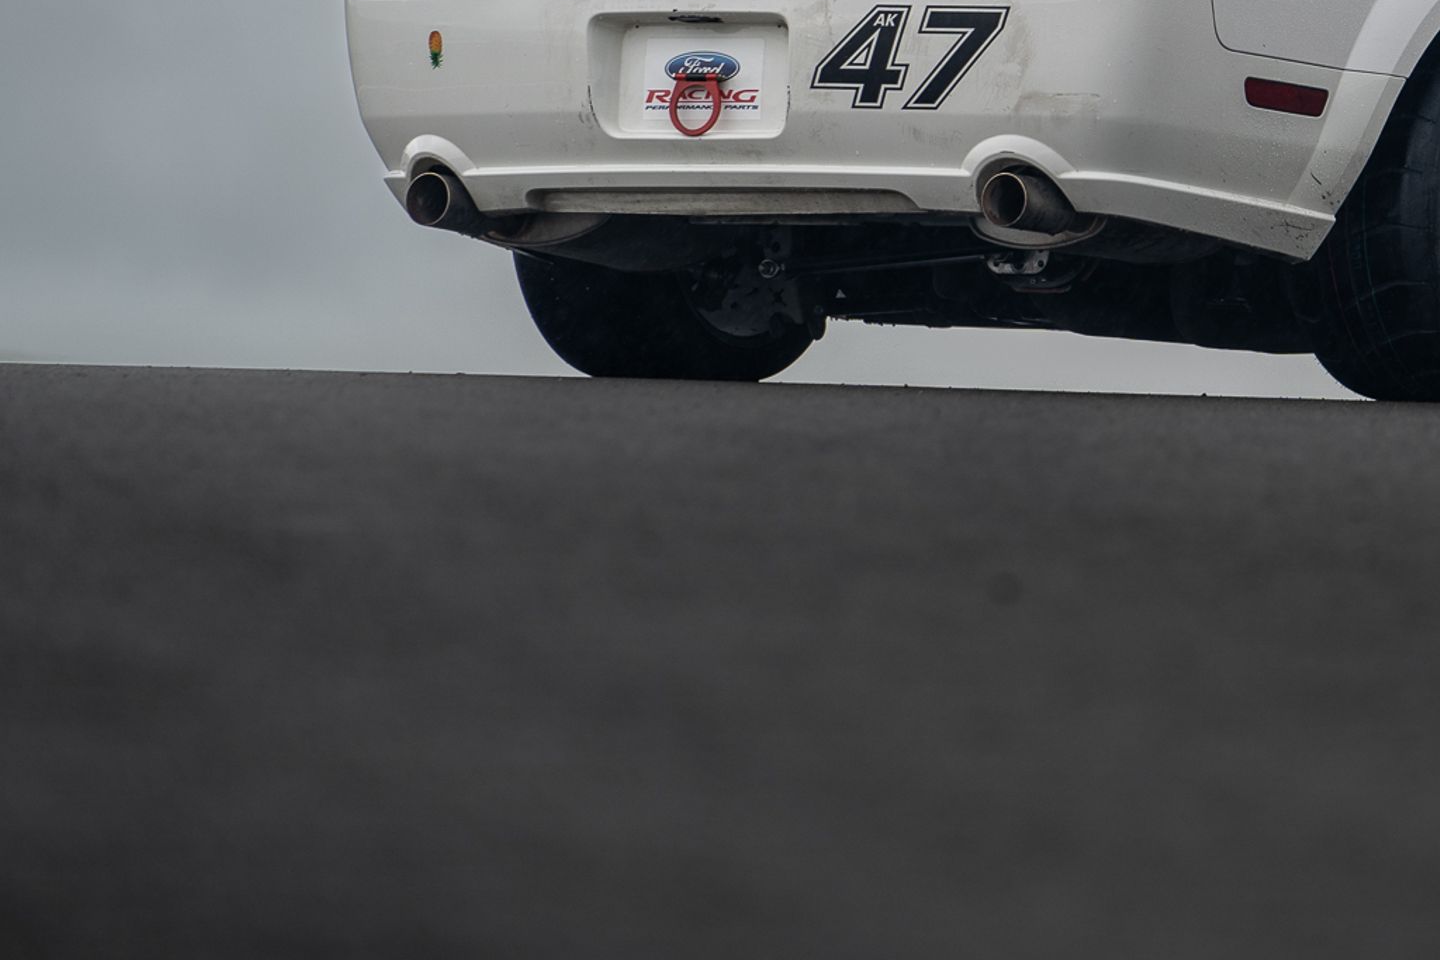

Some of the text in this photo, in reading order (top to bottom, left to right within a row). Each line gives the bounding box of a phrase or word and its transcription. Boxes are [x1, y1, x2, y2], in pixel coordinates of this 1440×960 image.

[873, 13, 898, 27] AK
[672, 56, 725, 76] Ford
[810, 4, 1011, 110] 47
